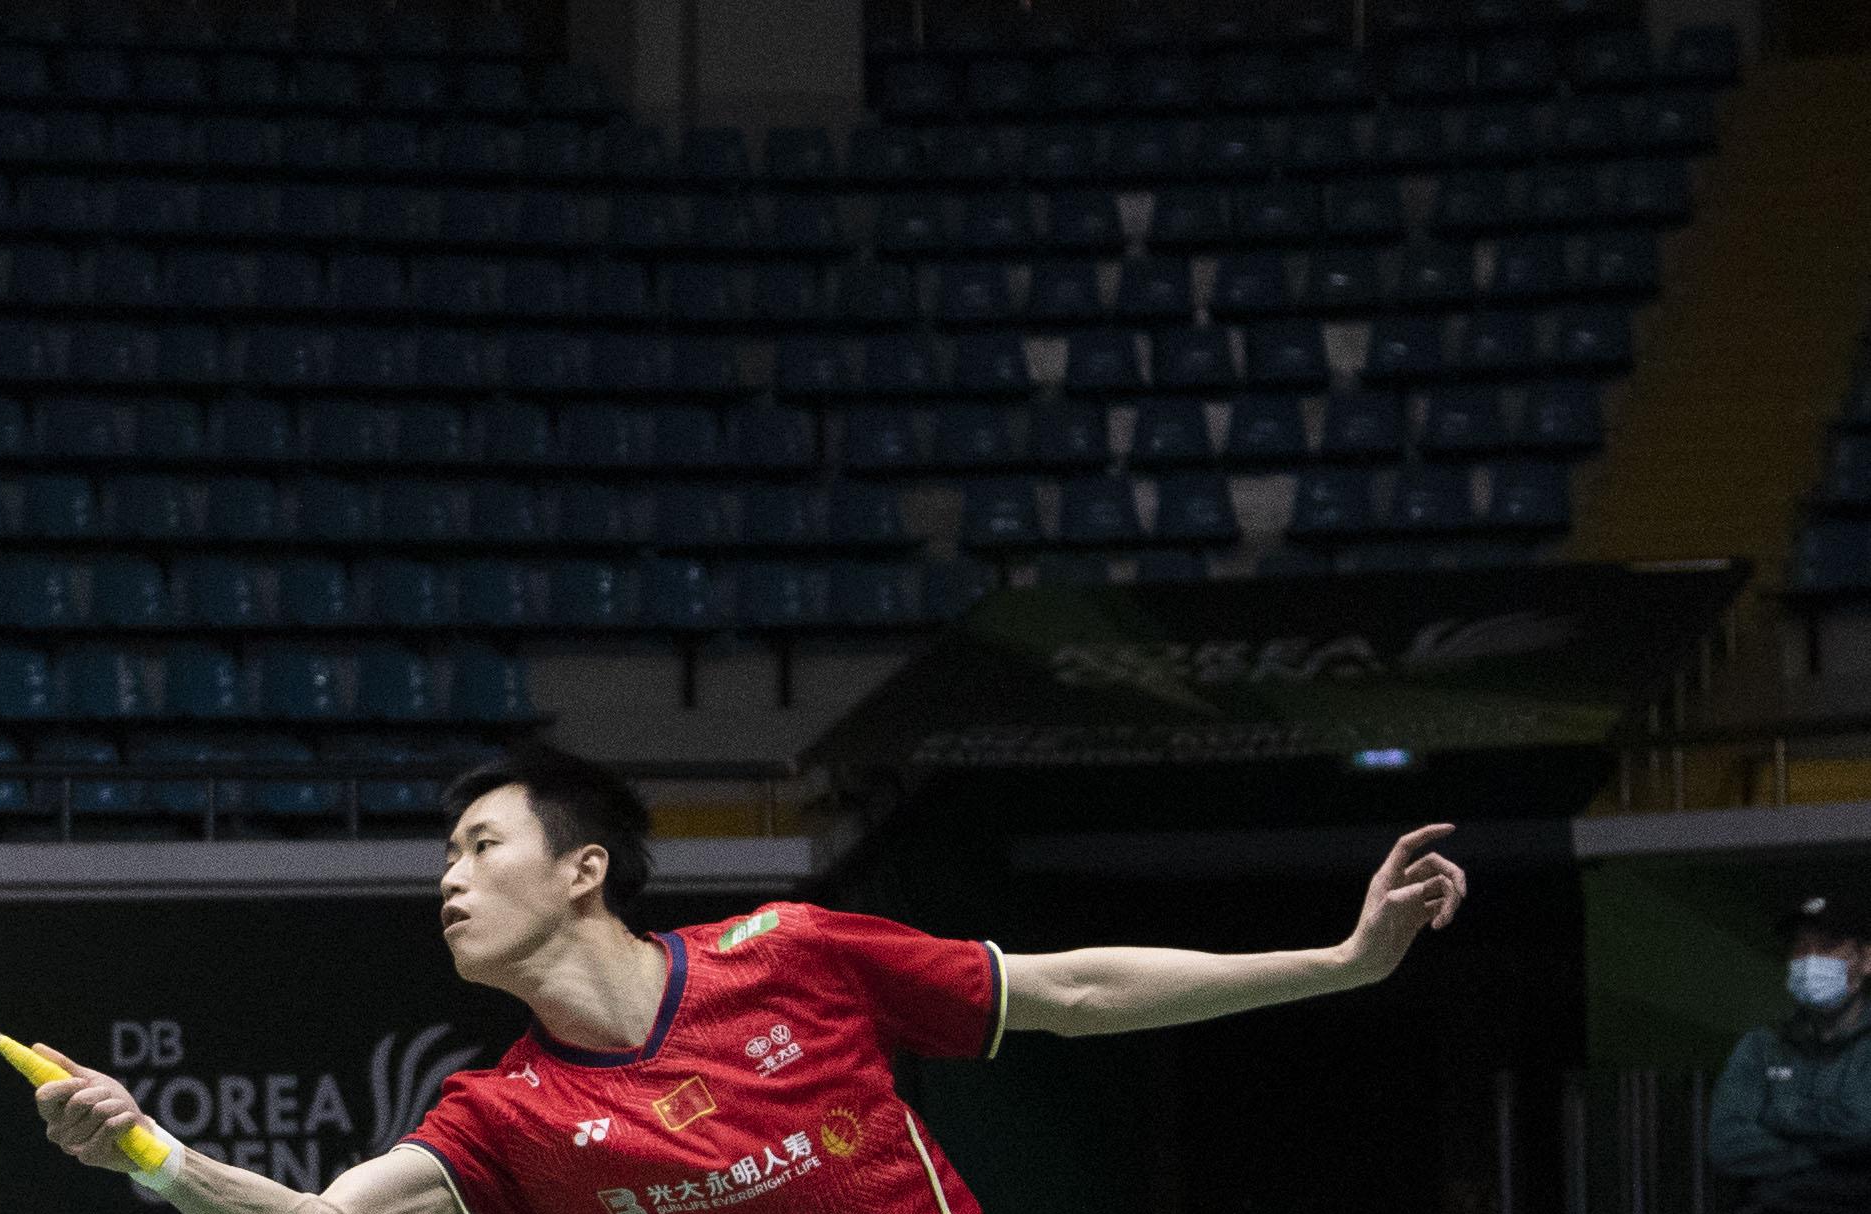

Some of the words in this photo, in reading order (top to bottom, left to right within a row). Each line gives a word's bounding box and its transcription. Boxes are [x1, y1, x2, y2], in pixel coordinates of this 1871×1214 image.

[111, 1021, 185, 1067] DB
[646, 1131, 813, 1205] 光大永明人寿
[684, 1199, 711, 1212] LIFE
[713, 1169, 793, 1207] EVERBRIGHT
[795, 1154, 822, 1176] LIFE
